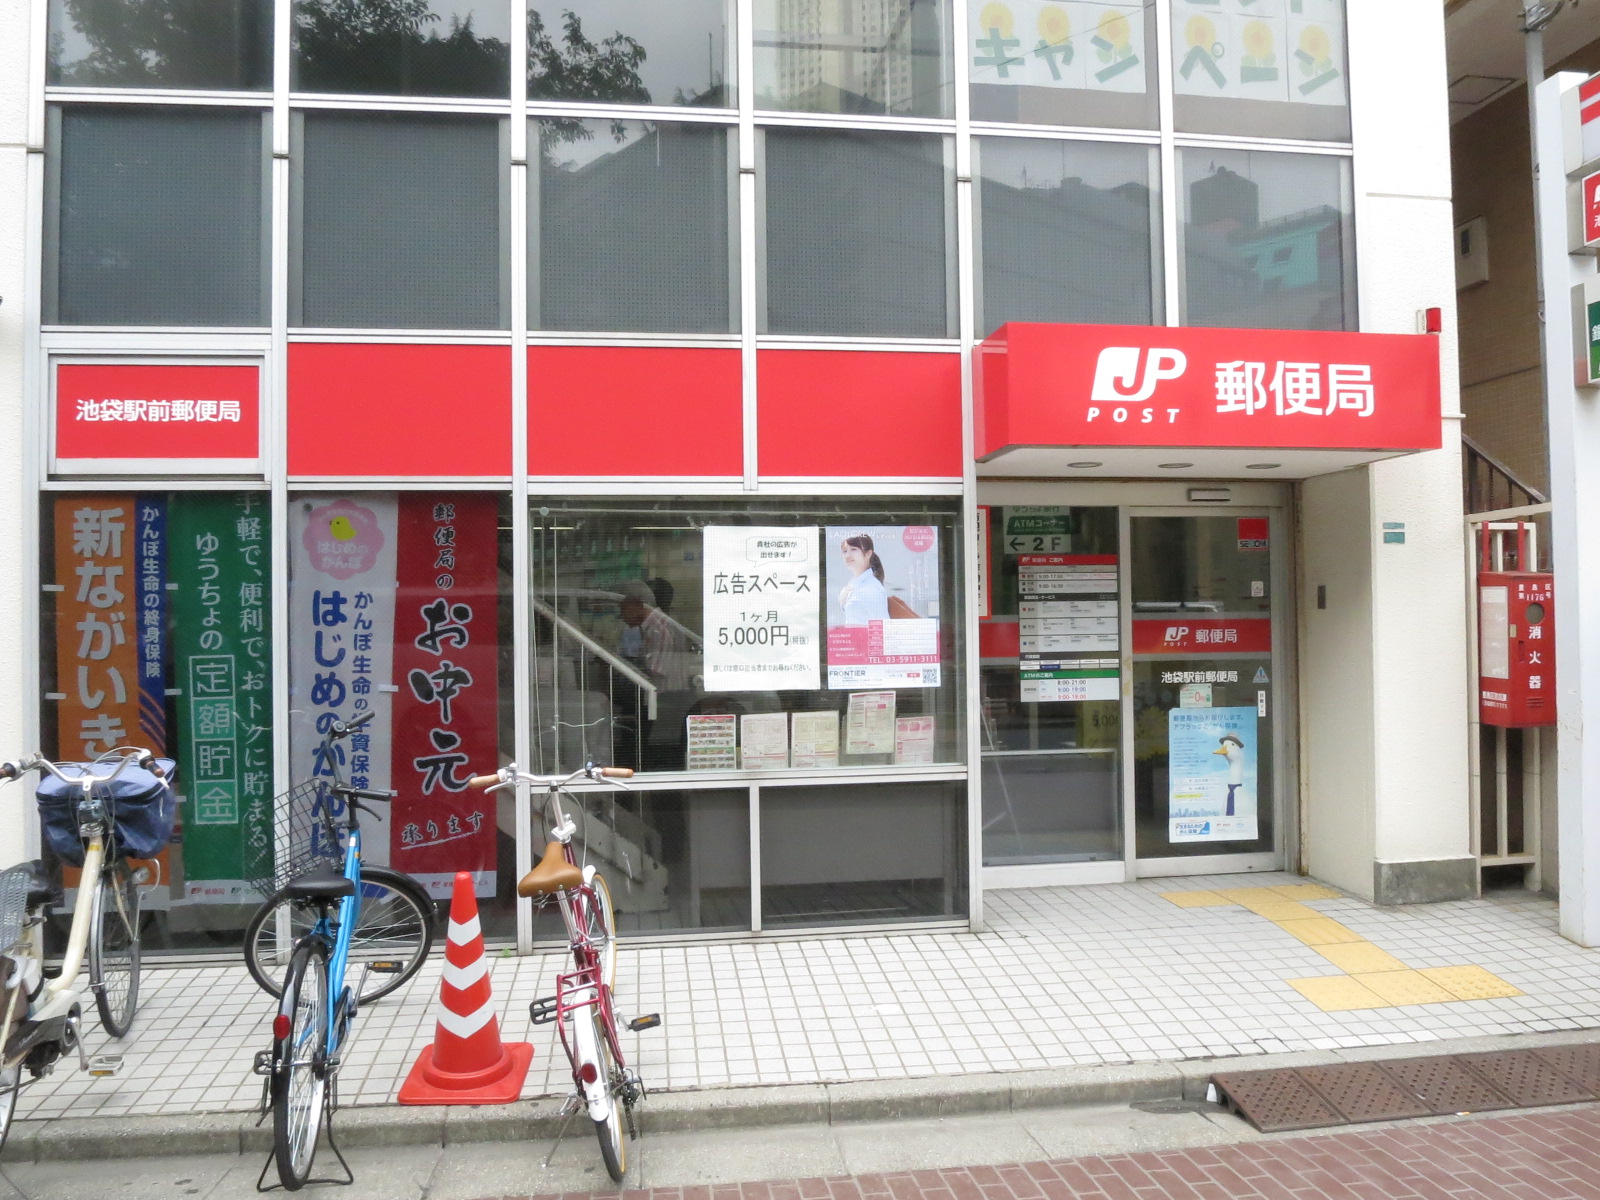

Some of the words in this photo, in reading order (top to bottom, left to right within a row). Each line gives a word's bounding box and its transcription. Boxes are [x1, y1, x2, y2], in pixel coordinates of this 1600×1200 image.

[1091, 347, 1187, 402] JP
[1215, 360, 1375, 417] 郵便局
[75, 399, 242, 423] 池袋駅前郵便局
[1086, 407, 1180, 424] POST
[1013, 519, 1066, 528] ATMコーナー
[433, 503, 456, 590] 郵便局の
[142, 506, 161, 678] かんぽ生命の終身保険
[713, 572, 811, 594] 広告スペース
[73, 507, 127, 760] 新ながいき
[1195, 629, 1238, 643] 郵便局
[885, 655, 938, 664] 03-5911-3111
[1528, 626, 1542, 689] 消火器
[829, 669, 866, 677] FRONTIER
[1161, 671, 1238, 683] 池袋駅前郵便局
[408, 598, 478, 796] お中元
[401, 811, 484, 845] 承ります
